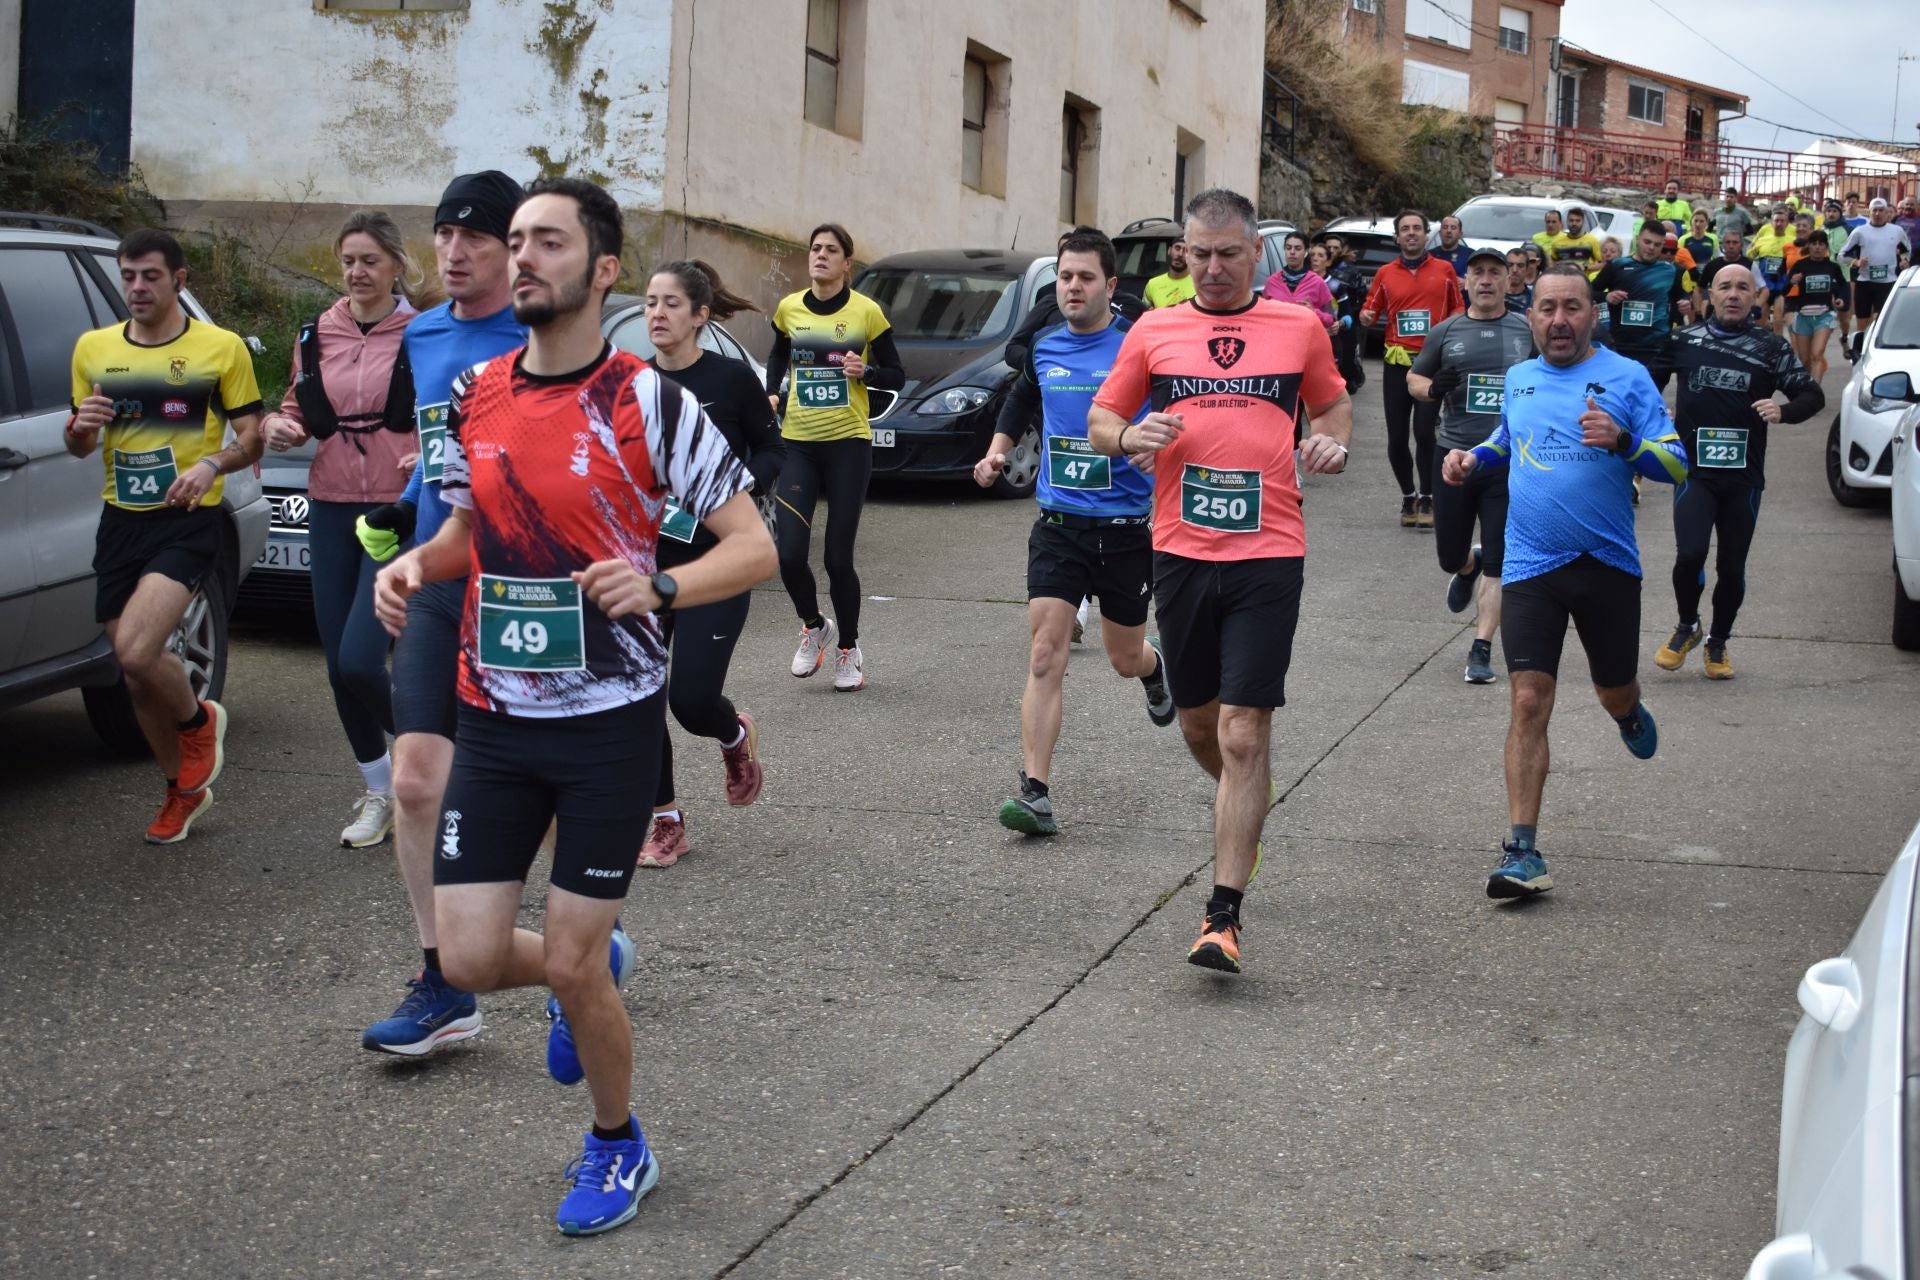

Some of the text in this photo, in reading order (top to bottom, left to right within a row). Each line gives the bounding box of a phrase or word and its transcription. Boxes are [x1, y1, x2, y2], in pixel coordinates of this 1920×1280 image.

[1630, 311, 1645, 321] 50
[1402, 320, 1425, 331] 139
[805, 385, 840, 402] 195
[1171, 379, 1280, 399] ANDOSILLA
[1199, 397, 1249, 409] CLUB ATLÉTICO
[874, 431, 892, 445] LC
[1705, 445, 1738, 460] 223
[1064, 461, 1092, 480] 47
[127, 474, 160, 495] 24
[1192, 494, 1248, 520] 250
[508, 584, 553, 594] CAJA RURAL
[519, 593, 558, 601] NAVARRA
[501, 619, 549, 654] 49
